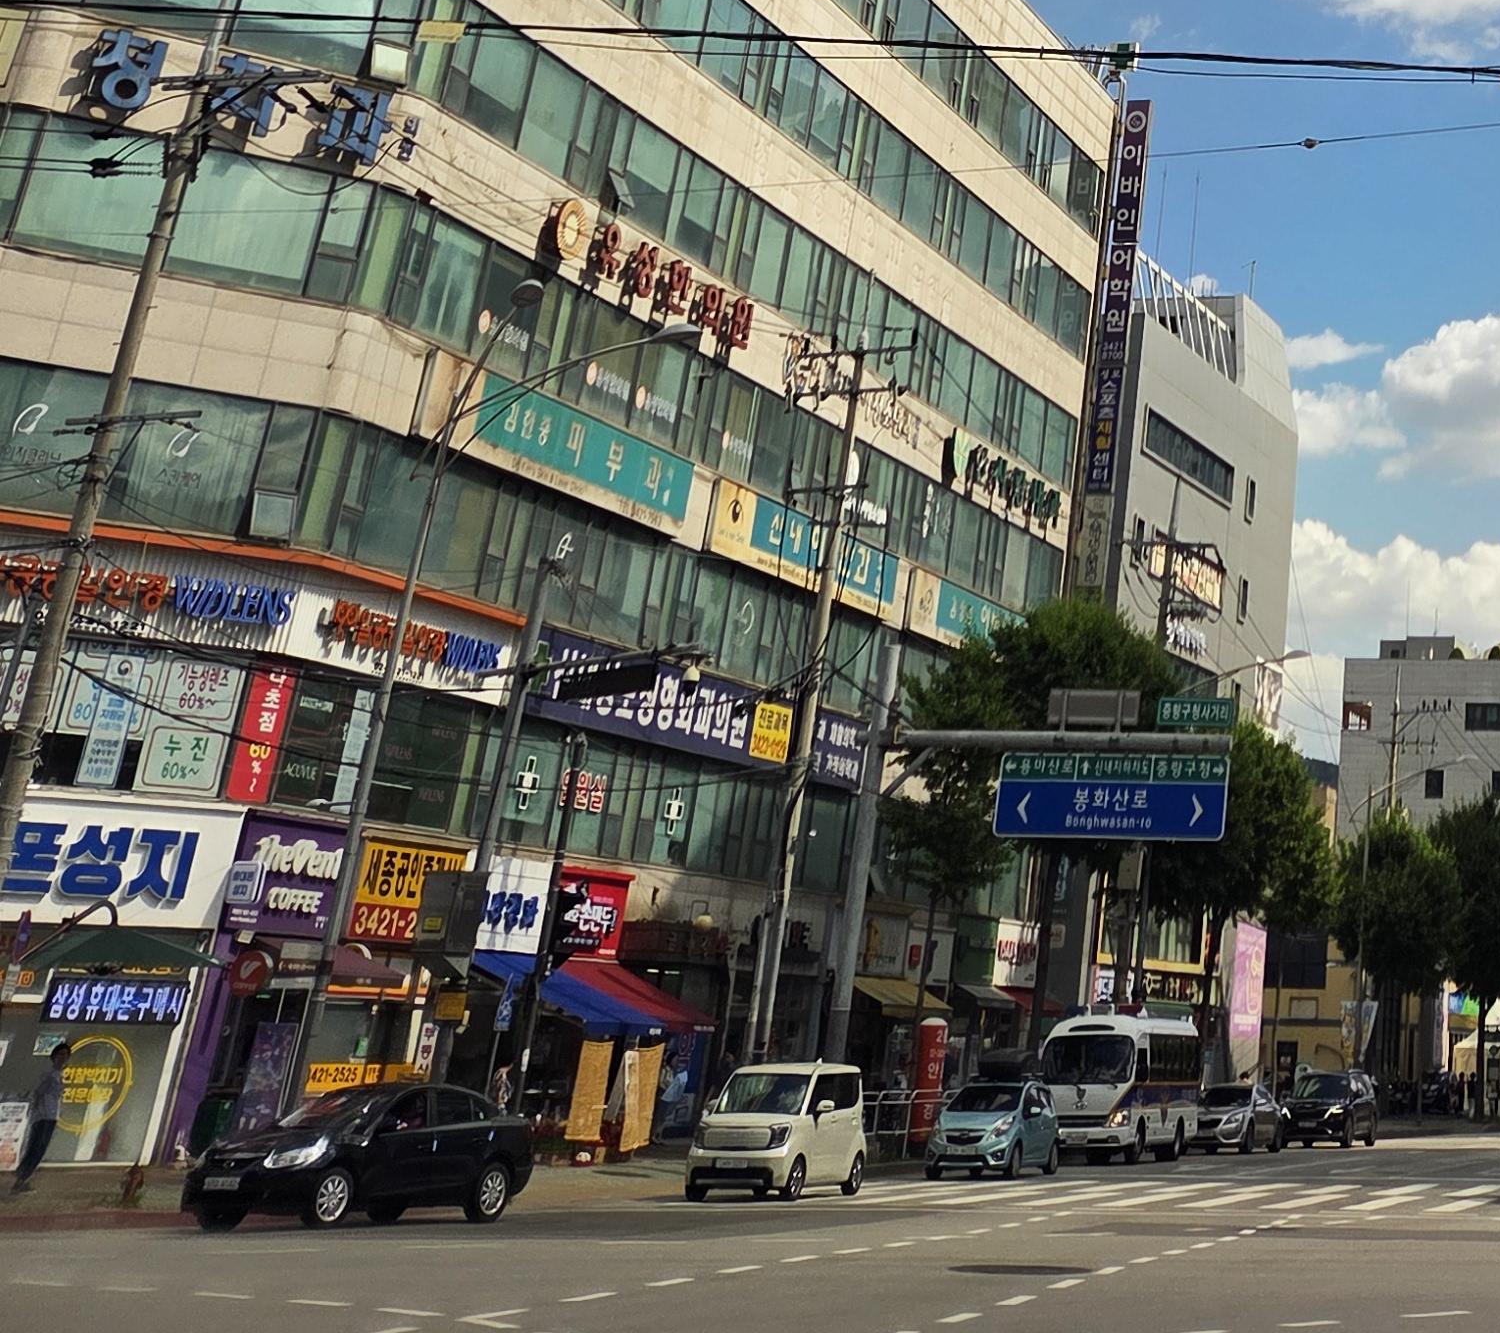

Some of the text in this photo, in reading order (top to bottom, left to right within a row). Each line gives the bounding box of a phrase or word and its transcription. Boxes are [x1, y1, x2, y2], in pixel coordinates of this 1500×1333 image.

[1115, 142, 1144, 232] 이바인
[1106, 247, 1136, 334] 어학원
[1092, 451, 1111, 483] 센터
[173, 573, 297, 625] WIDLENS
[177, 664, 231, 693] 기능성렌즈
[1162, 701, 1230, 722] 중랑구청사거리
[163, 733, 209, 763] 누진
[1019, 760, 1074, 776] 용마산로
[1094, 760, 1149, 776] 신내지하차도
[1156, 760, 1213, 779] 중랑구청
[1073, 787, 1149, 813] 봉화산로
[1064, 814, 1152, 830] Bonghwasan-ro
[267, 886, 324, 914] COFFEE
[354, 905, 418, 939] 3421-2
